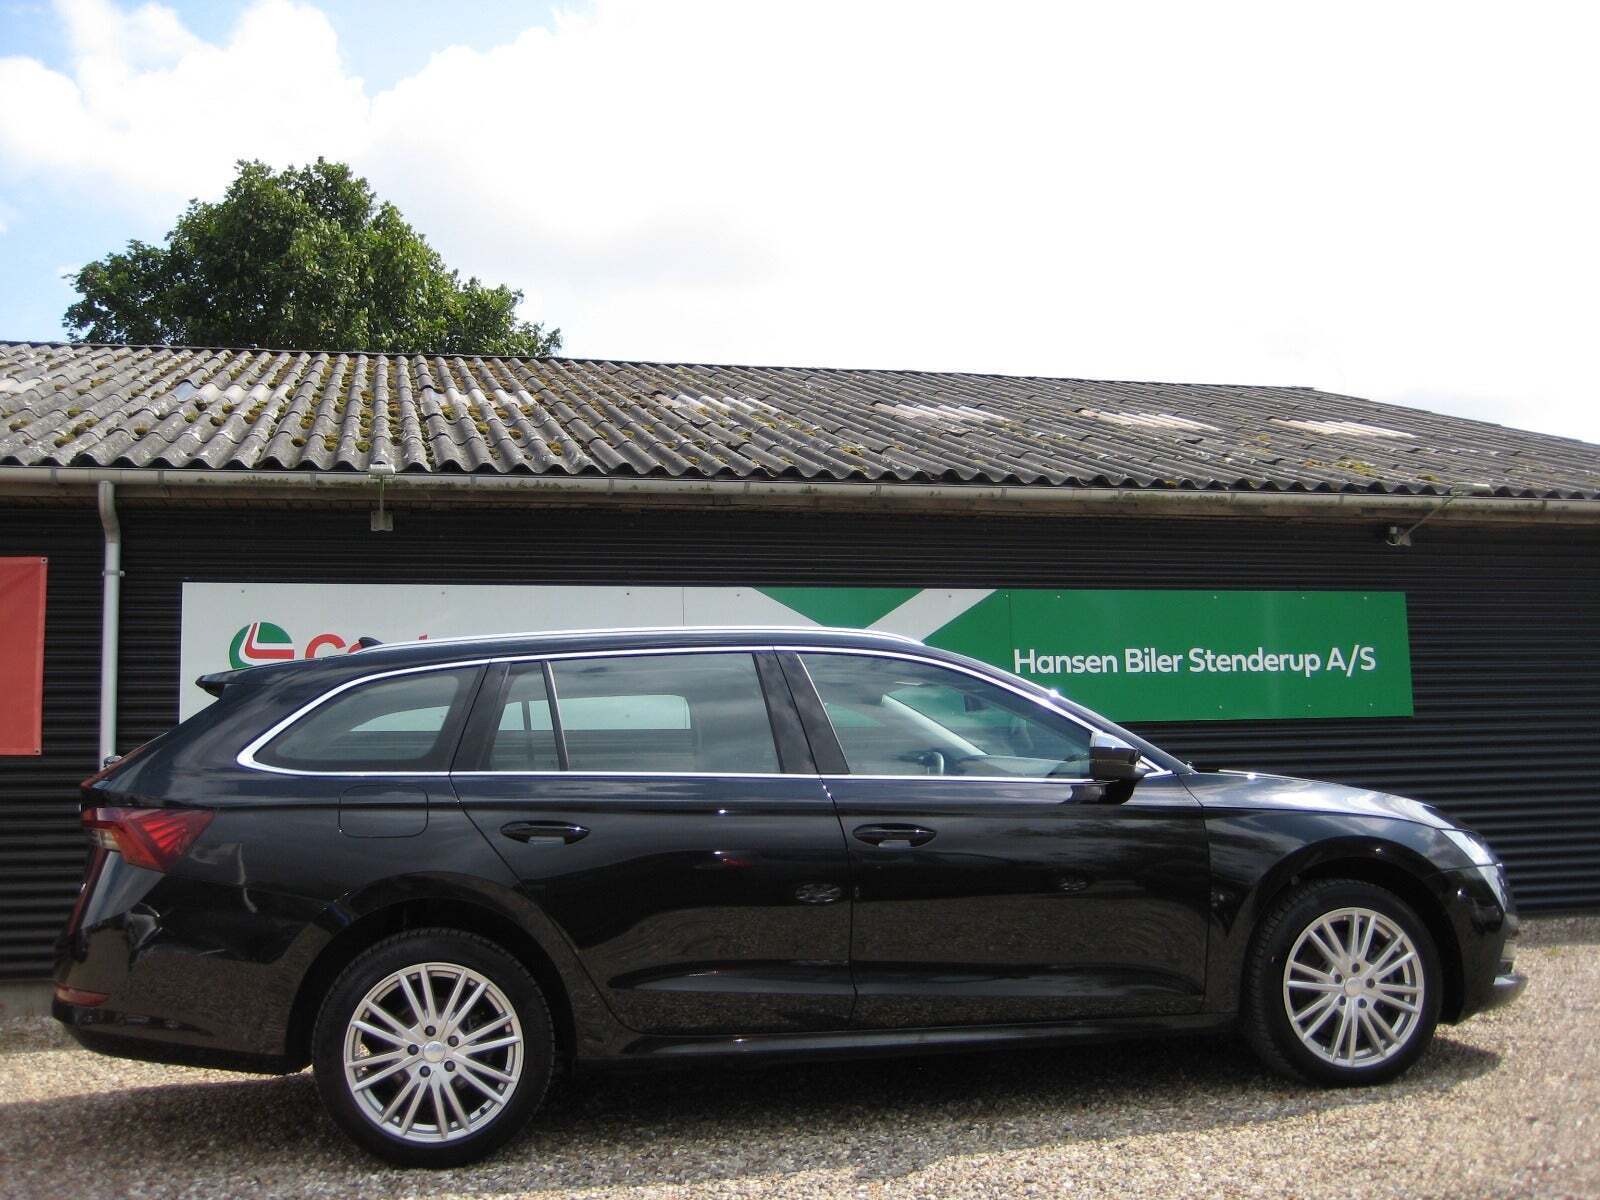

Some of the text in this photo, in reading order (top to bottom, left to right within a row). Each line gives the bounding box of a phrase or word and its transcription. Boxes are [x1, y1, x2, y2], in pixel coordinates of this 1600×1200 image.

[1013, 644, 1376, 678] Hansen Biler Stenderup A/S
